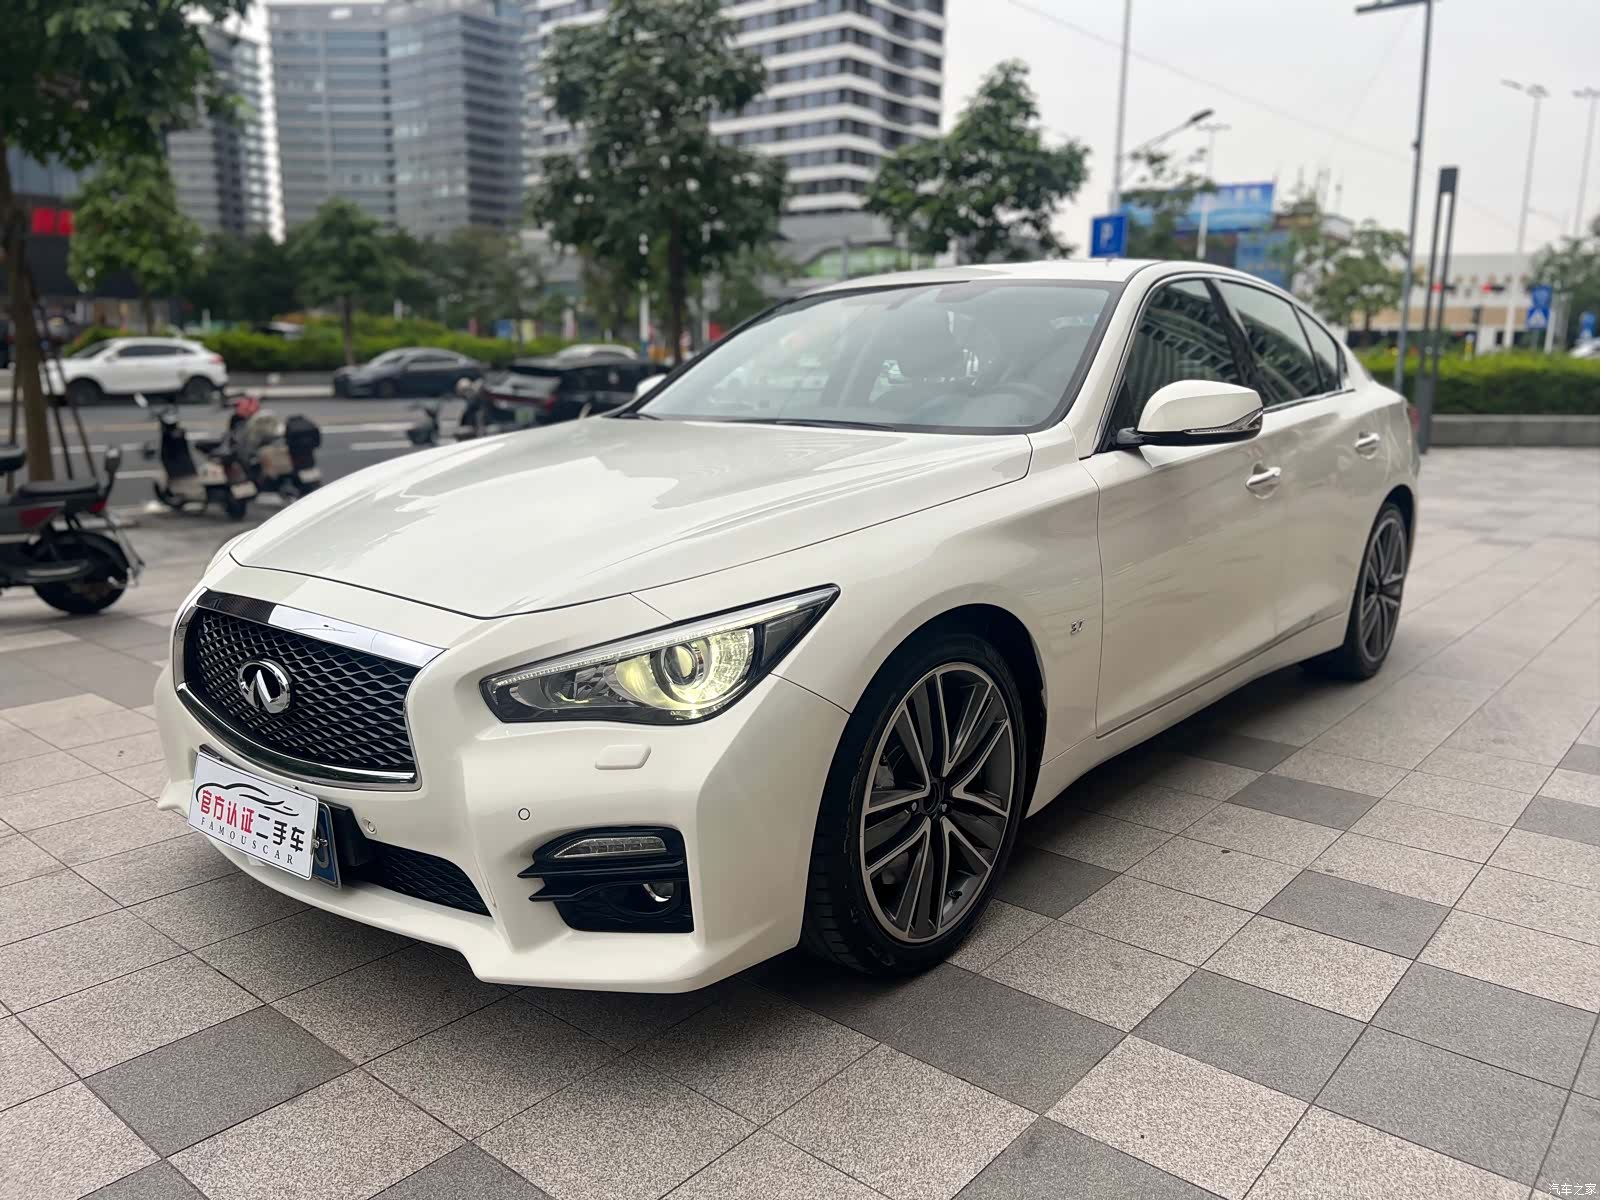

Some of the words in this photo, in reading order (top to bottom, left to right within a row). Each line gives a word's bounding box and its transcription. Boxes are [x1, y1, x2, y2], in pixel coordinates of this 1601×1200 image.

[200, 789, 305, 852] 官方认证二手车
